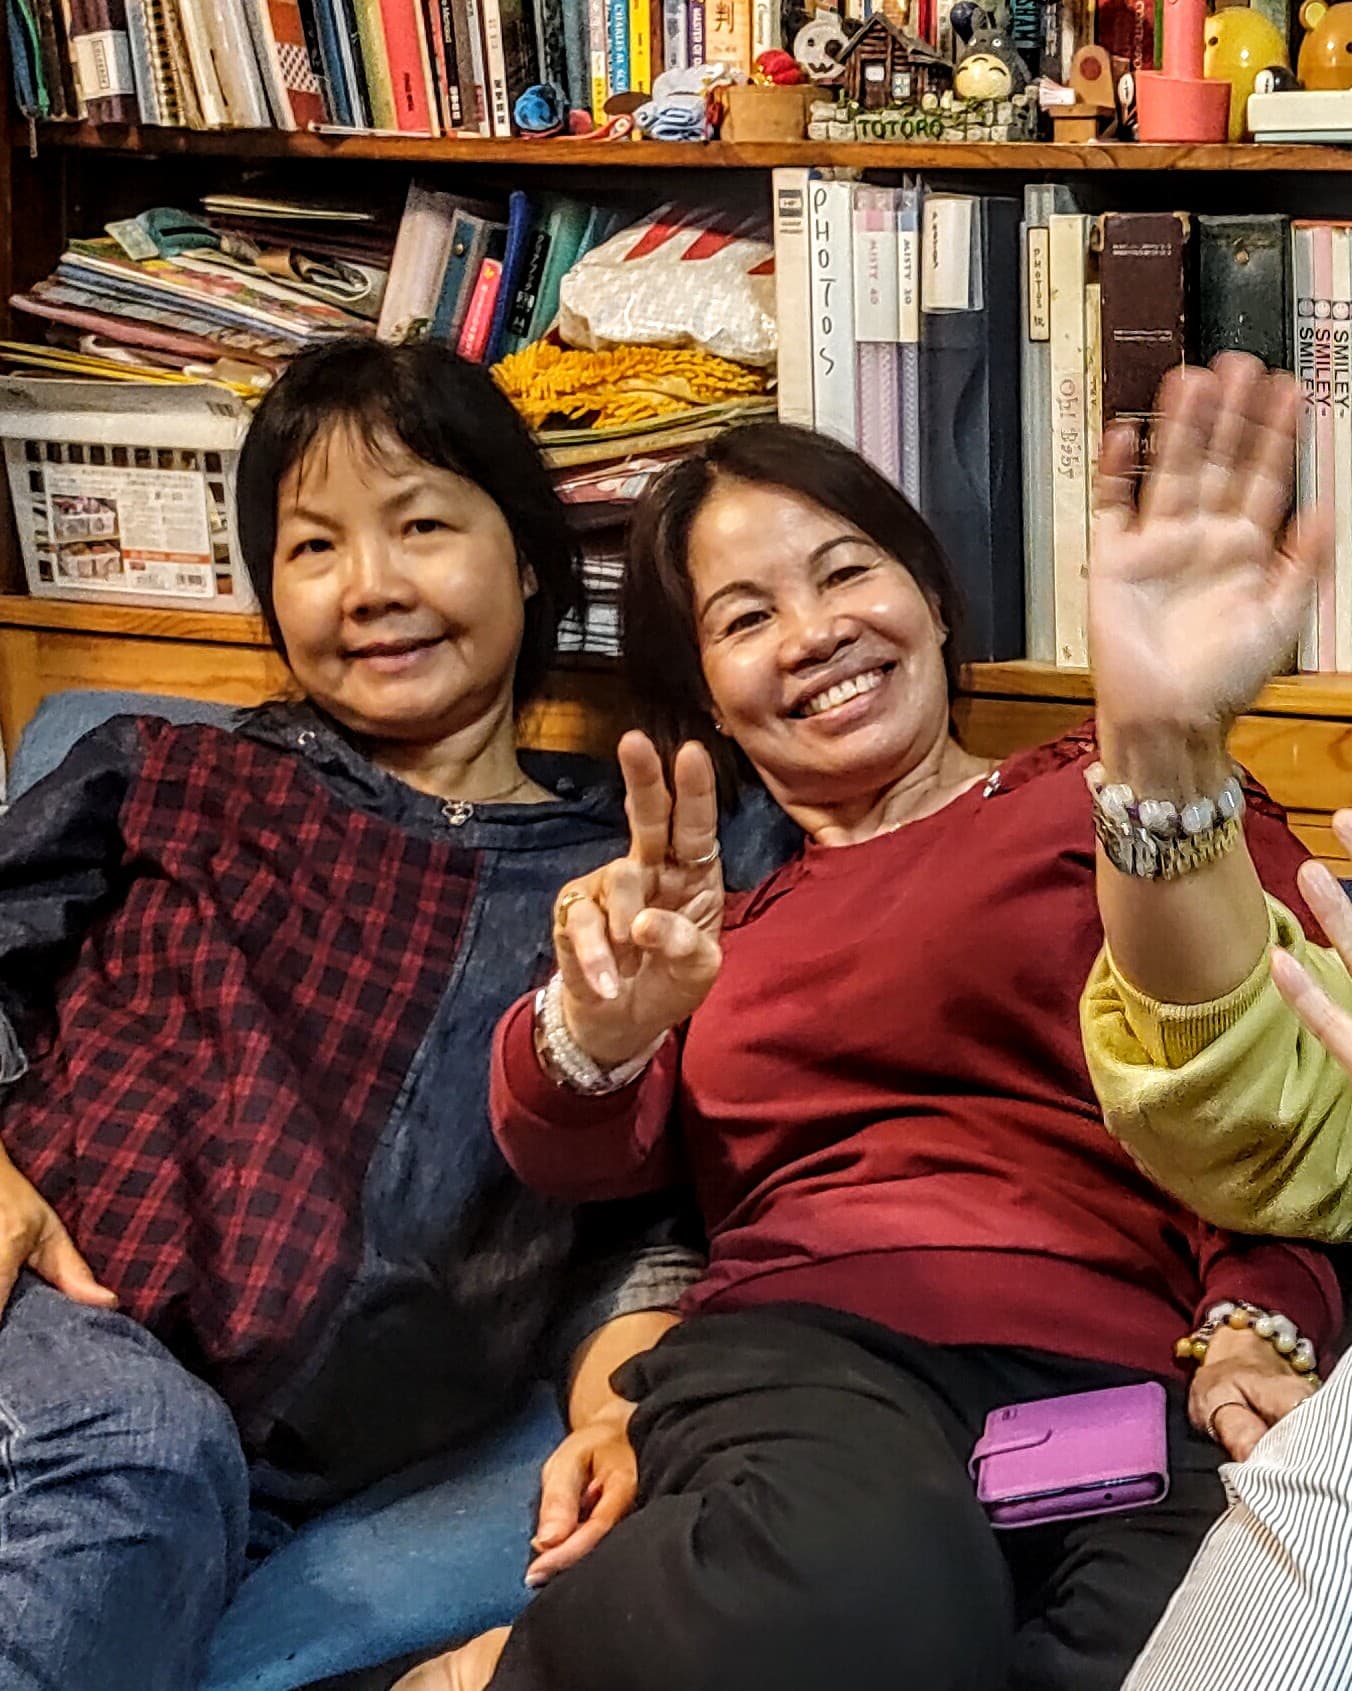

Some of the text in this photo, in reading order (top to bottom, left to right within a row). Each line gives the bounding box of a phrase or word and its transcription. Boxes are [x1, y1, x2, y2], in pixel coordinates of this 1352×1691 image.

[857, 117, 943, 140] TOTORO
[813, 187, 836, 376] PHOTOS
[868, 239, 879, 280] MISTY
[903, 239, 913, 280] MISTY
[1315, 328, 1331, 407] SMILEY
[1333, 329, 1350, 409] SMILEY
